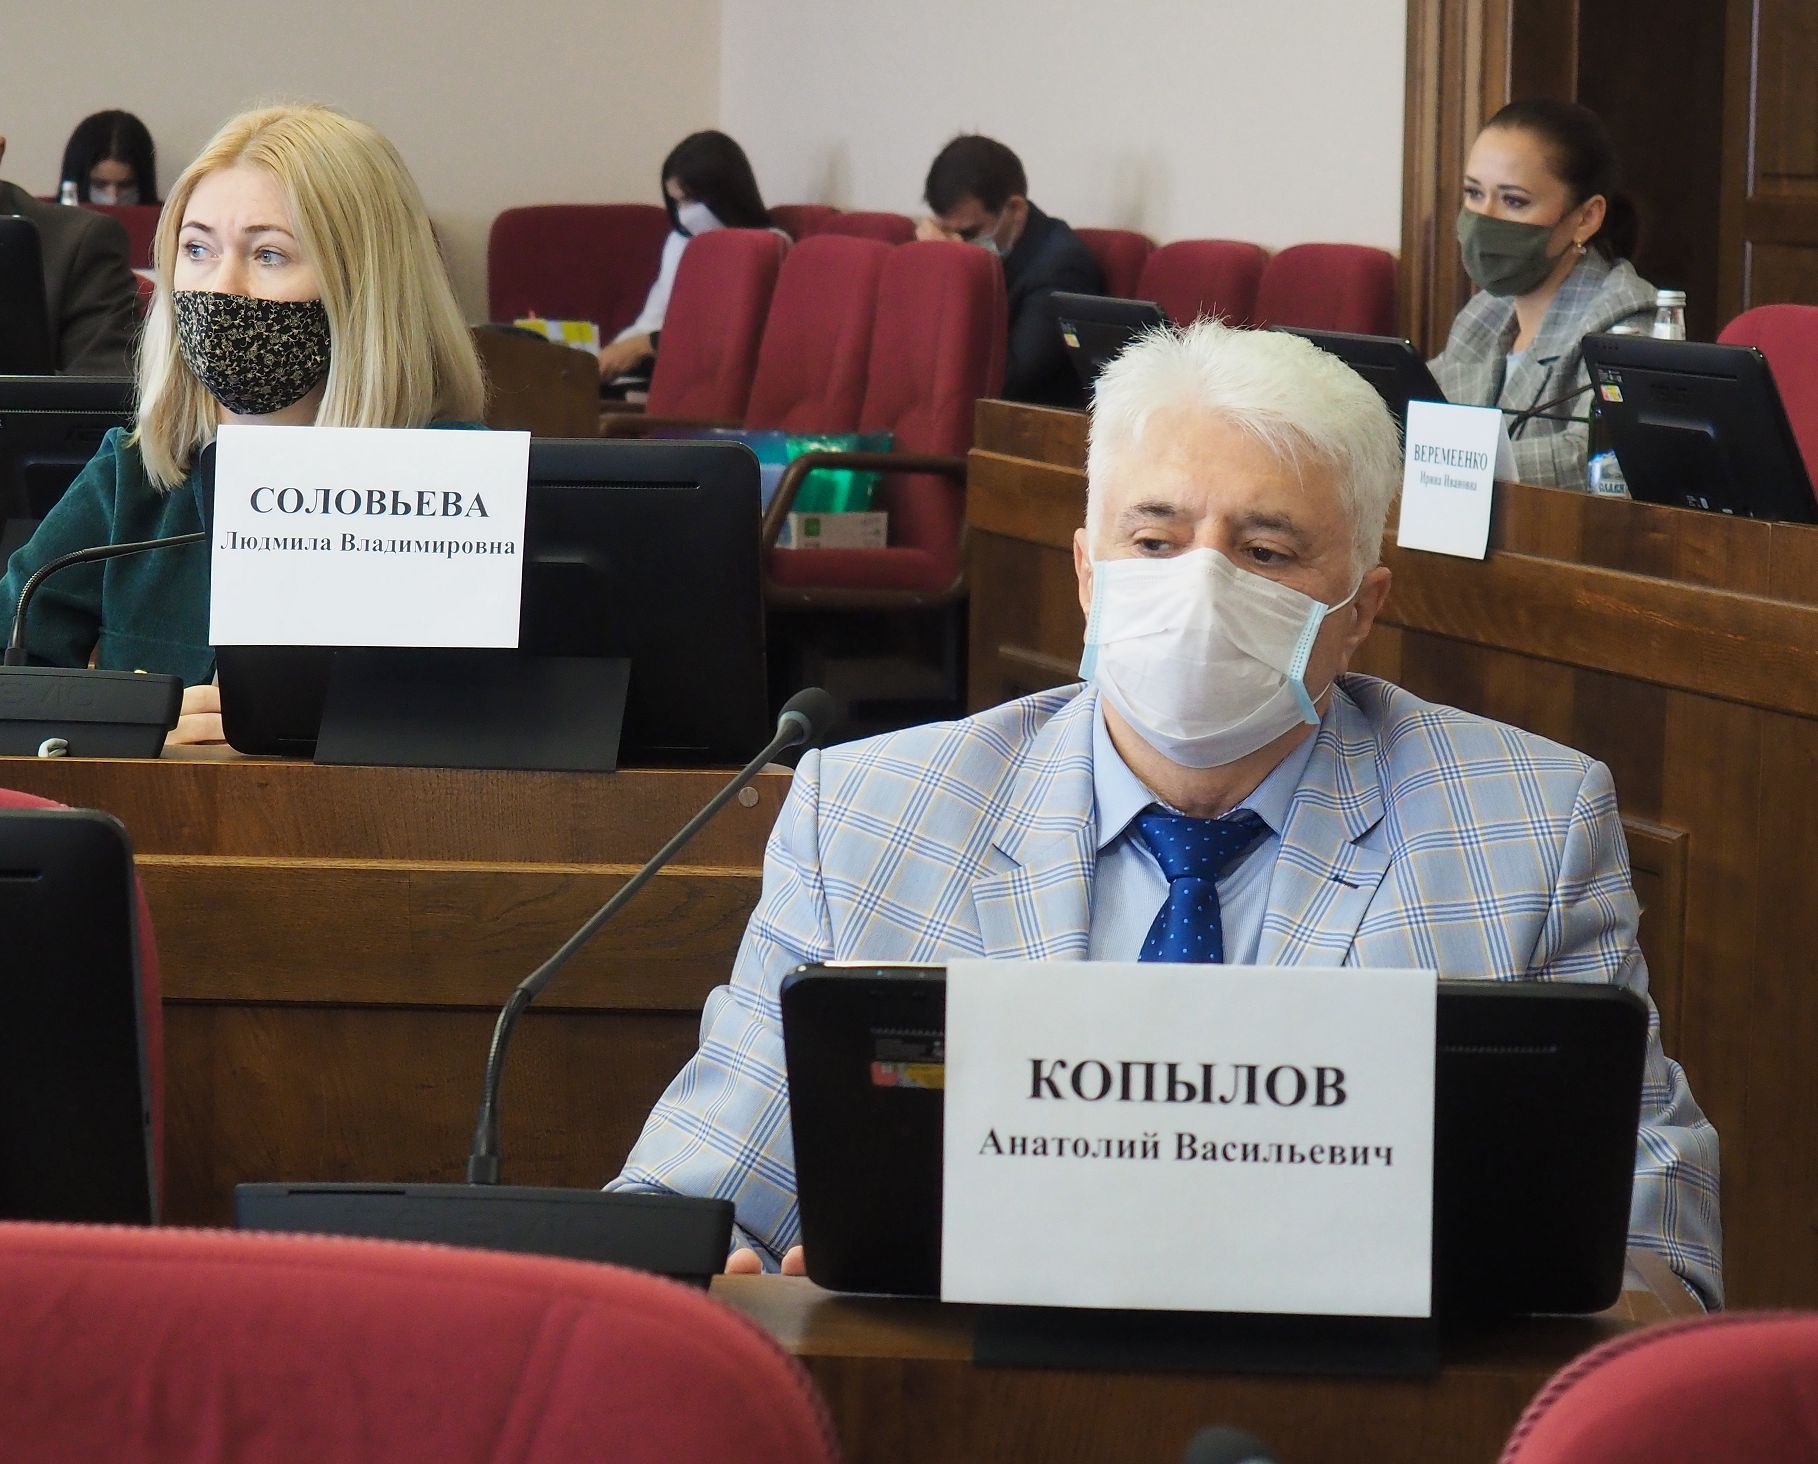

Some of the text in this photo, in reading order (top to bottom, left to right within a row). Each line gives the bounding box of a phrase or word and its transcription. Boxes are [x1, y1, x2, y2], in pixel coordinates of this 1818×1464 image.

[1414, 444, 1488, 471] ВЕРЕМЕЕНКО
[250, 486, 490, 518] СОЛОВЬЕВА
[220, 531, 516, 559] Людмила Владимировна
[1029, 1058, 1348, 1108] КОПЫЛОВ
[979, 1128, 1394, 1167] Анатолий Васильевич
